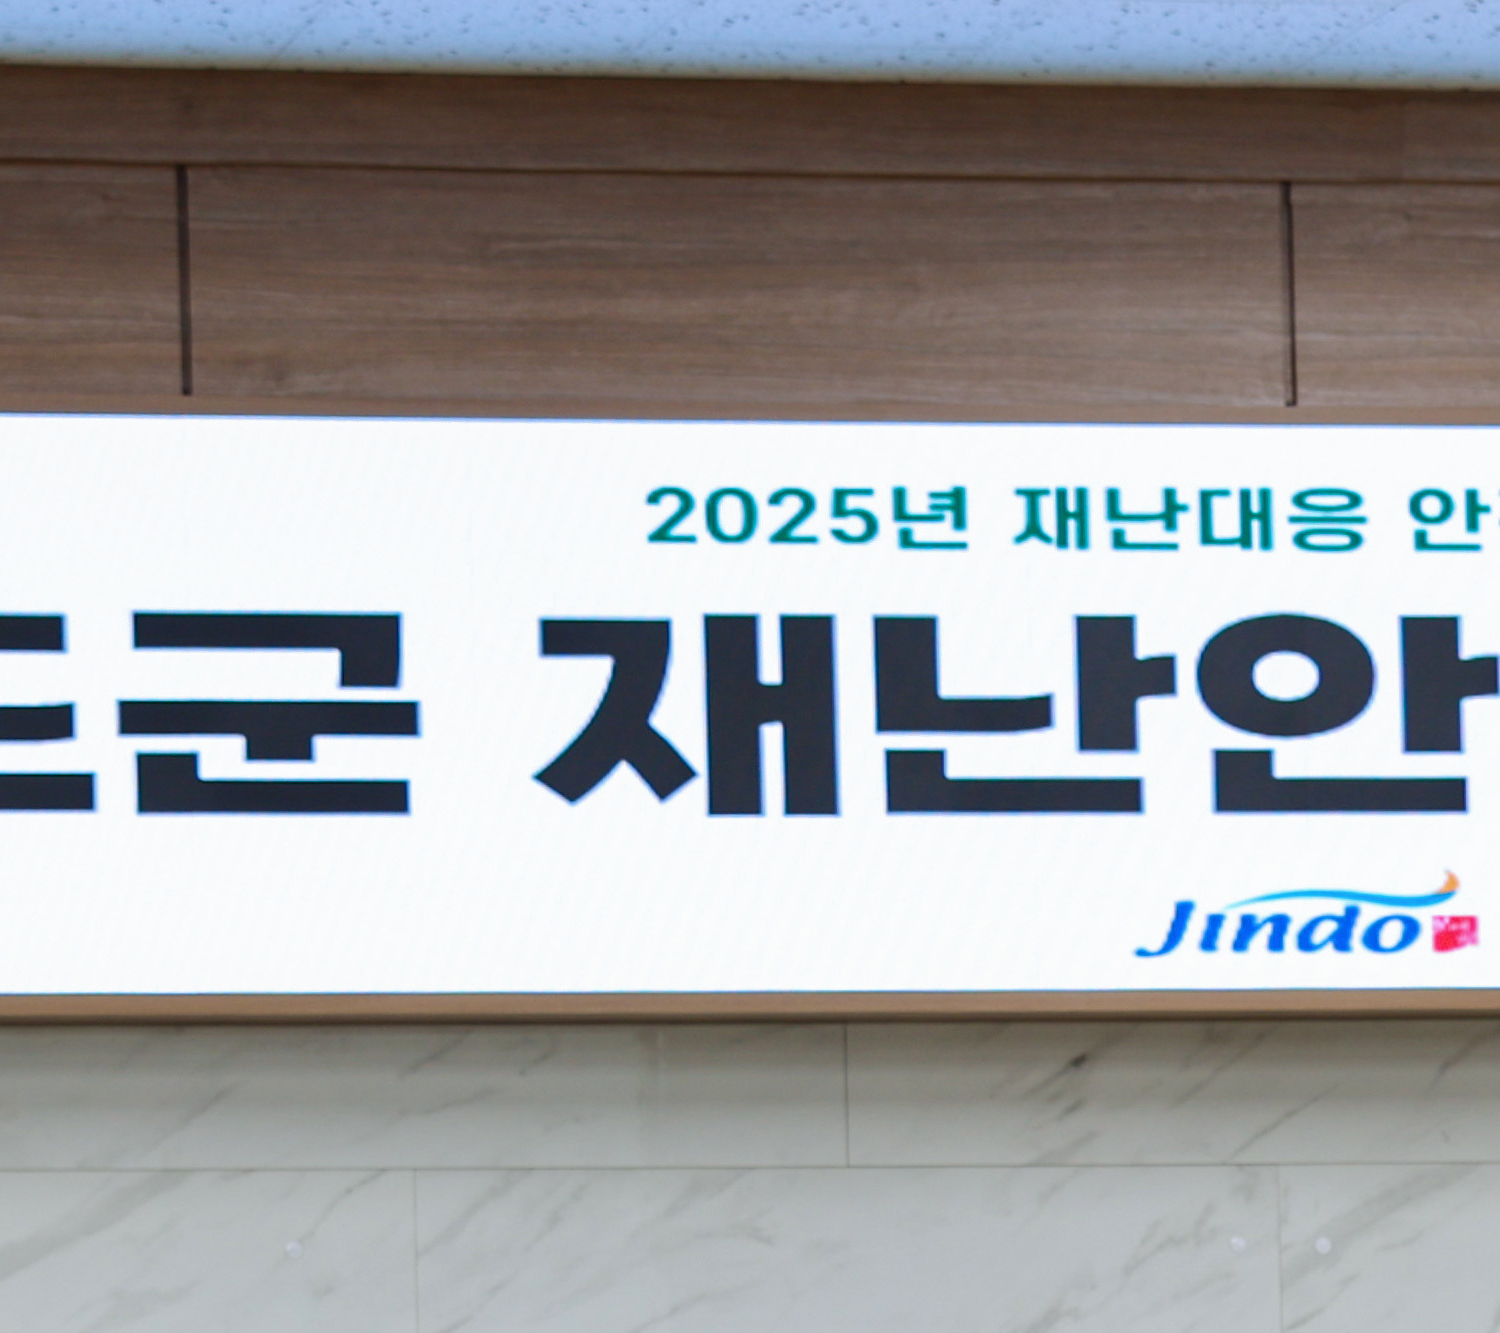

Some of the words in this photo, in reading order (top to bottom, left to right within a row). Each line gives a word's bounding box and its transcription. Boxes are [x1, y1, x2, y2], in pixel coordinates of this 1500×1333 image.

[646, 485, 969, 551] 2025년
[1013, 486, 1368, 553] 재난대응
[1134, 899, 1422, 957] Jindo
